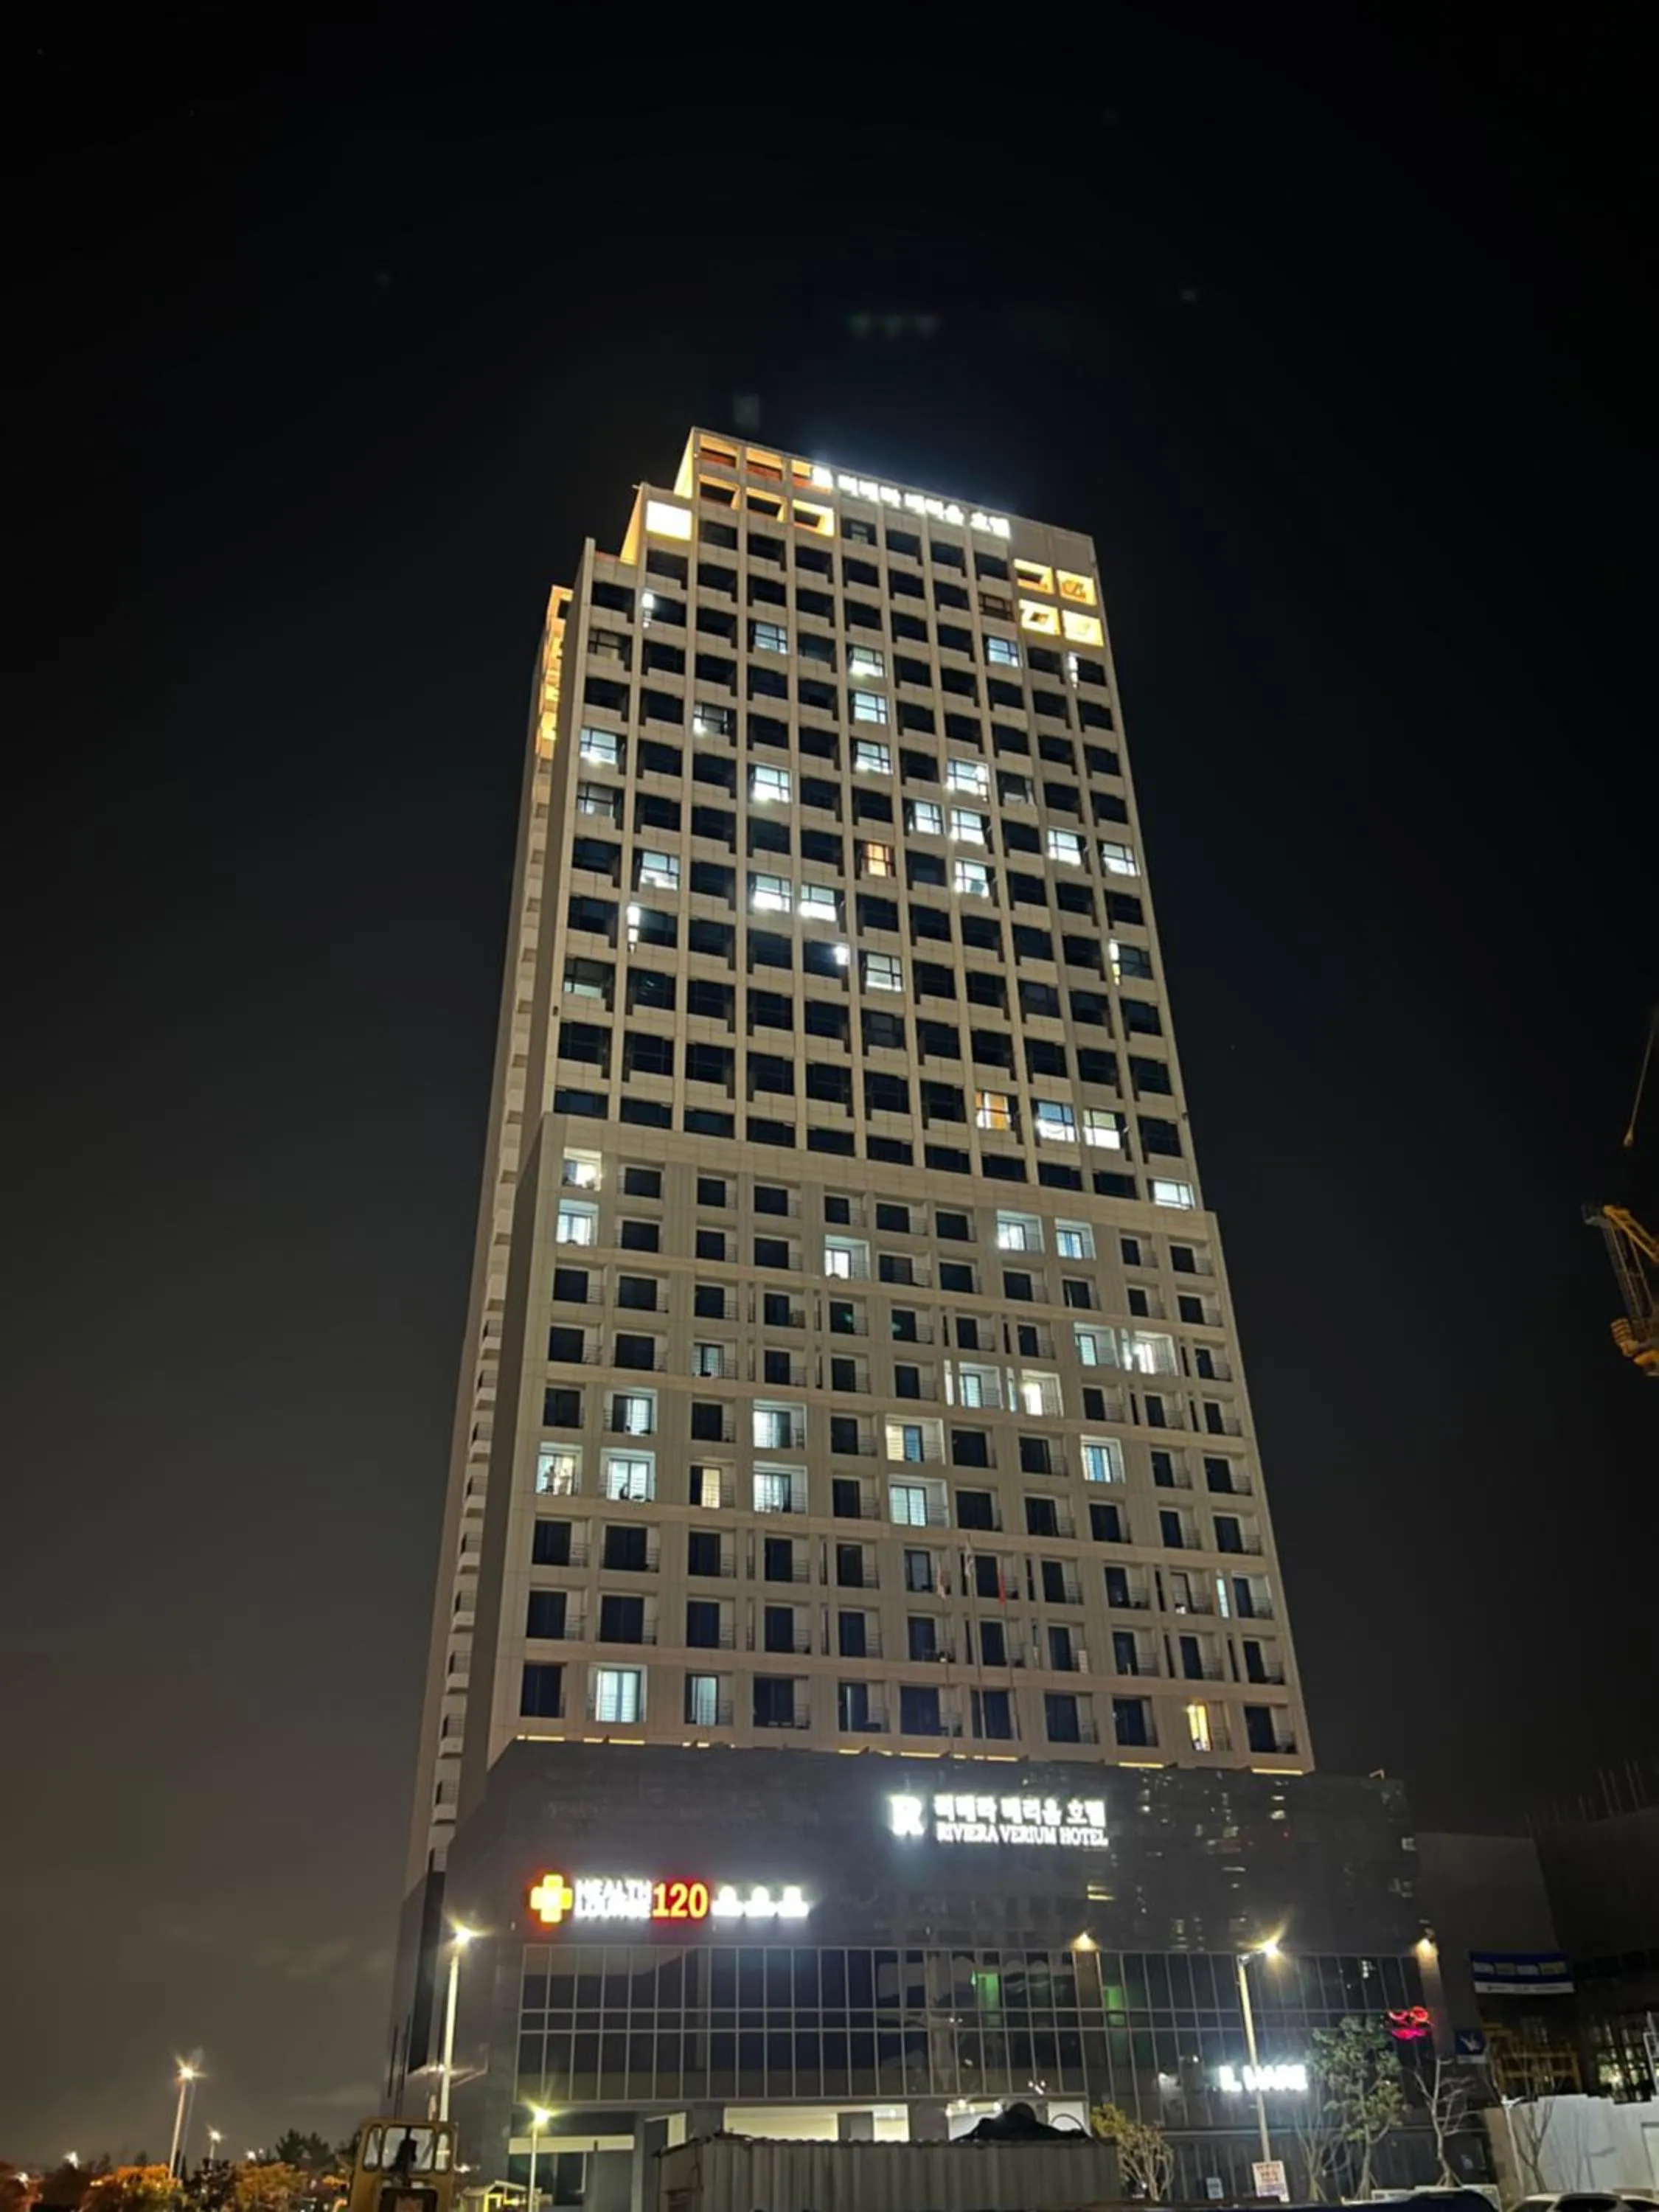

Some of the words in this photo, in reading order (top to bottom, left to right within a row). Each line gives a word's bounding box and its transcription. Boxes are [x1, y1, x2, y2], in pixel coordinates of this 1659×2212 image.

[937, 1823, 998, 1842] RIVIERA
[1000, 1825, 1057, 1844] VERIUM
[1060, 1827, 1109, 1846] HOTEL
[652, 1883, 708, 1917] 120
